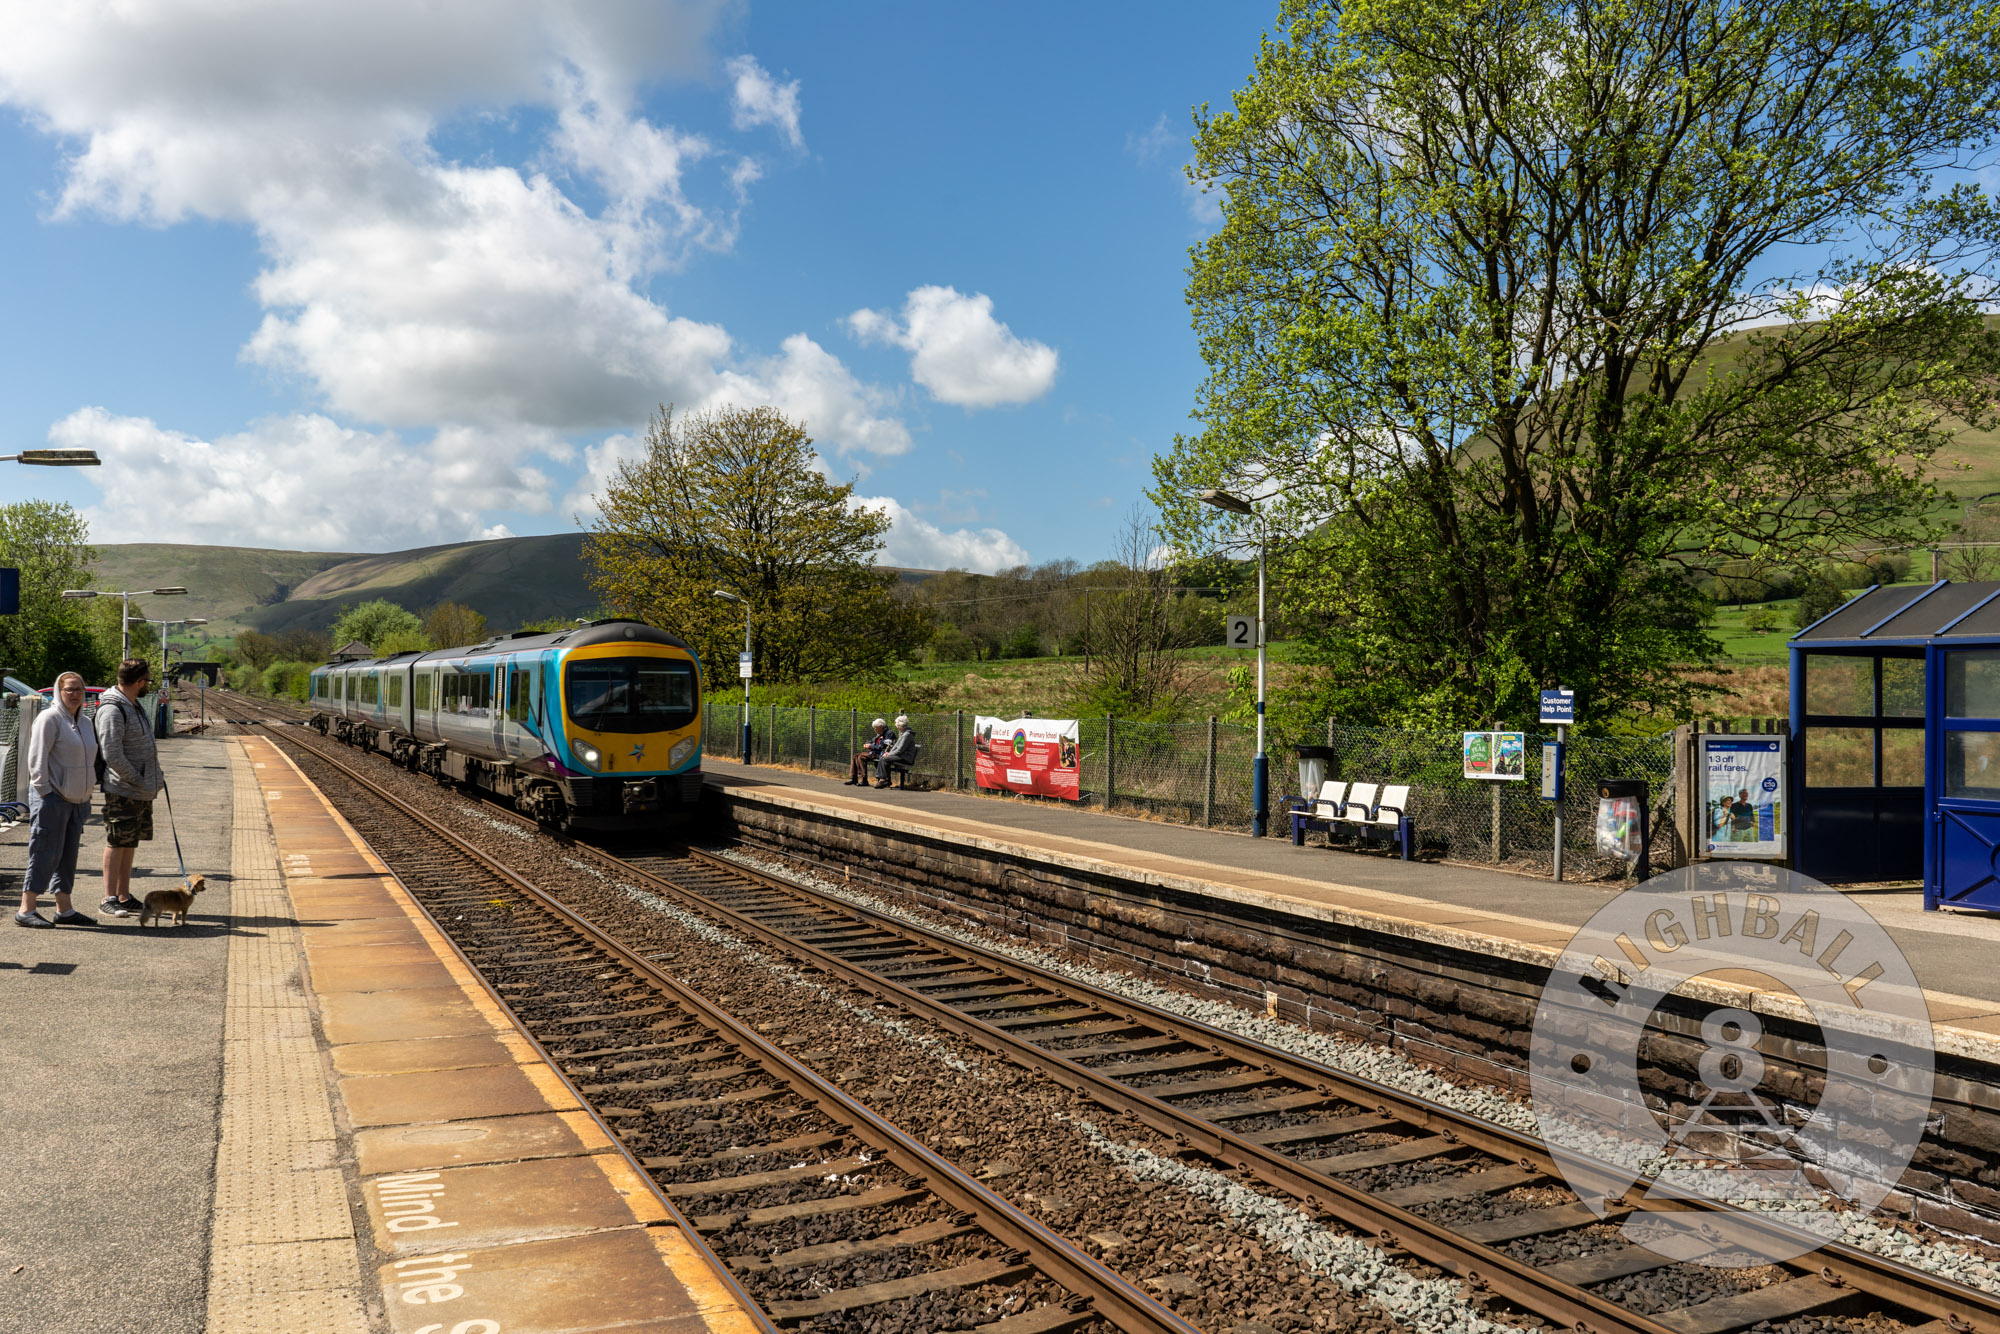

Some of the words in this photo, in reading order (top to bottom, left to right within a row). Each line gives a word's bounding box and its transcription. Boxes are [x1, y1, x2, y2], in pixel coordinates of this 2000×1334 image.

[1234, 621, 1248, 643] 2
[1029, 731, 1044, 740] Primary
[1708, 755, 1721, 763] 13
[1722, 755, 1734, 763] off
[376, 1172, 460, 1233] Mind
[394, 1253, 473, 1305] the
